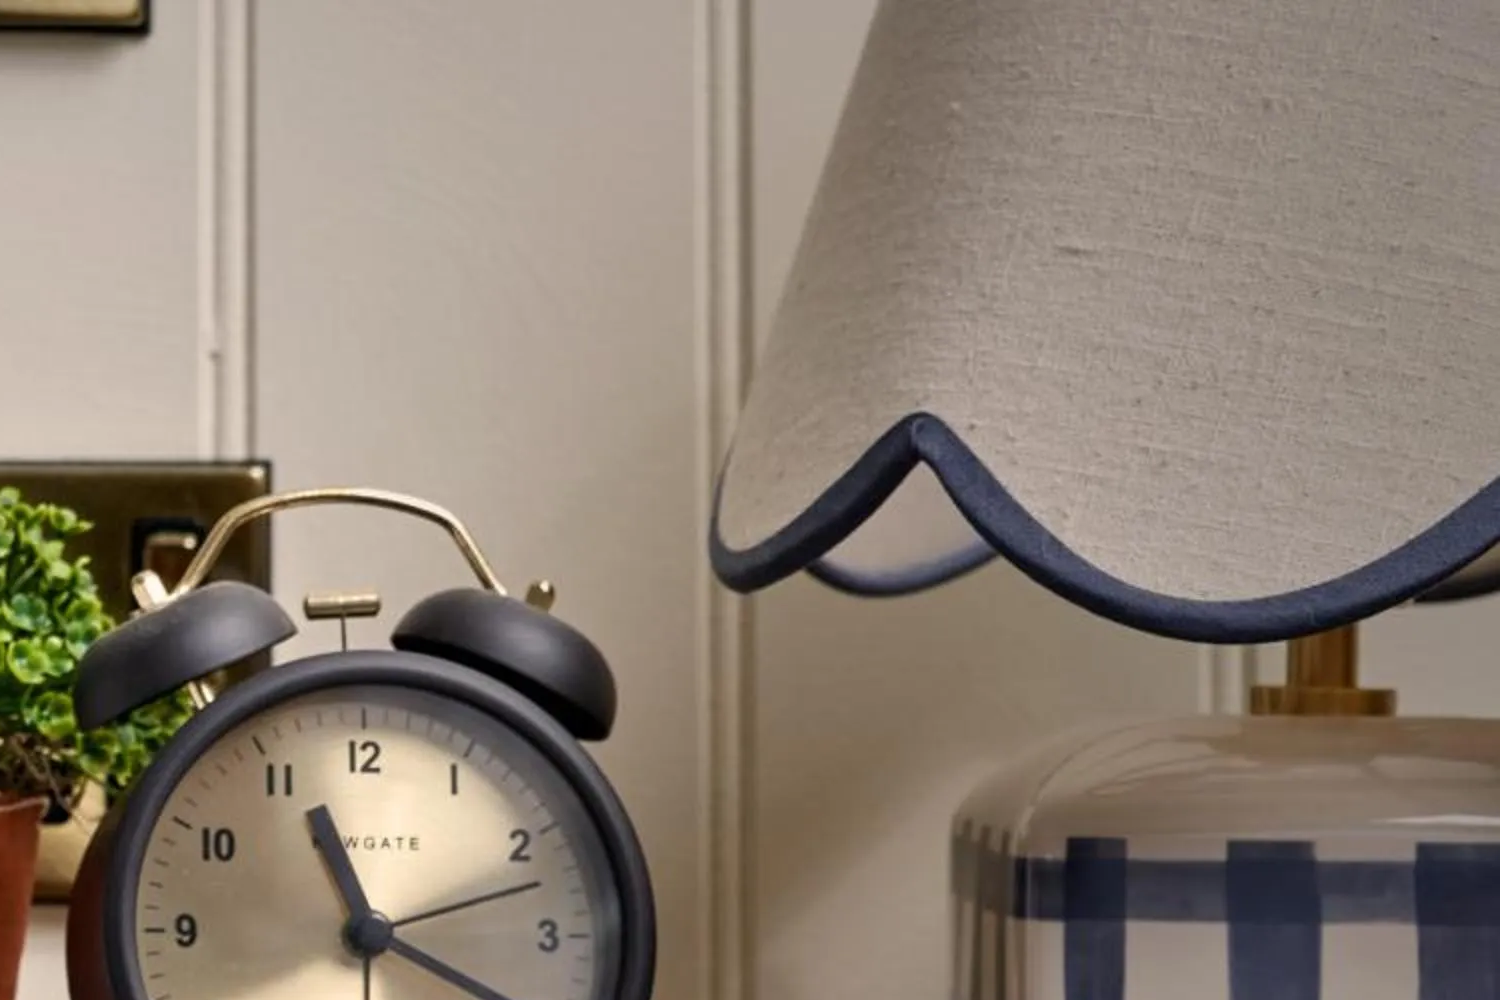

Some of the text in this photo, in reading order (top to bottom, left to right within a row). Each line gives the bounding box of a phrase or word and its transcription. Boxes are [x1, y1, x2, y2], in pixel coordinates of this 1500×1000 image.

[347, 740, 382, 774] 12
[266, 764, 293, 797] 11
[450, 764, 459, 797] 1
[201, 827, 236, 862] 10
[312, 835, 420, 851] WGATE
[508, 829, 531, 862] 2
[174, 914, 198, 947] 9
[537, 920, 560, 953] 3
